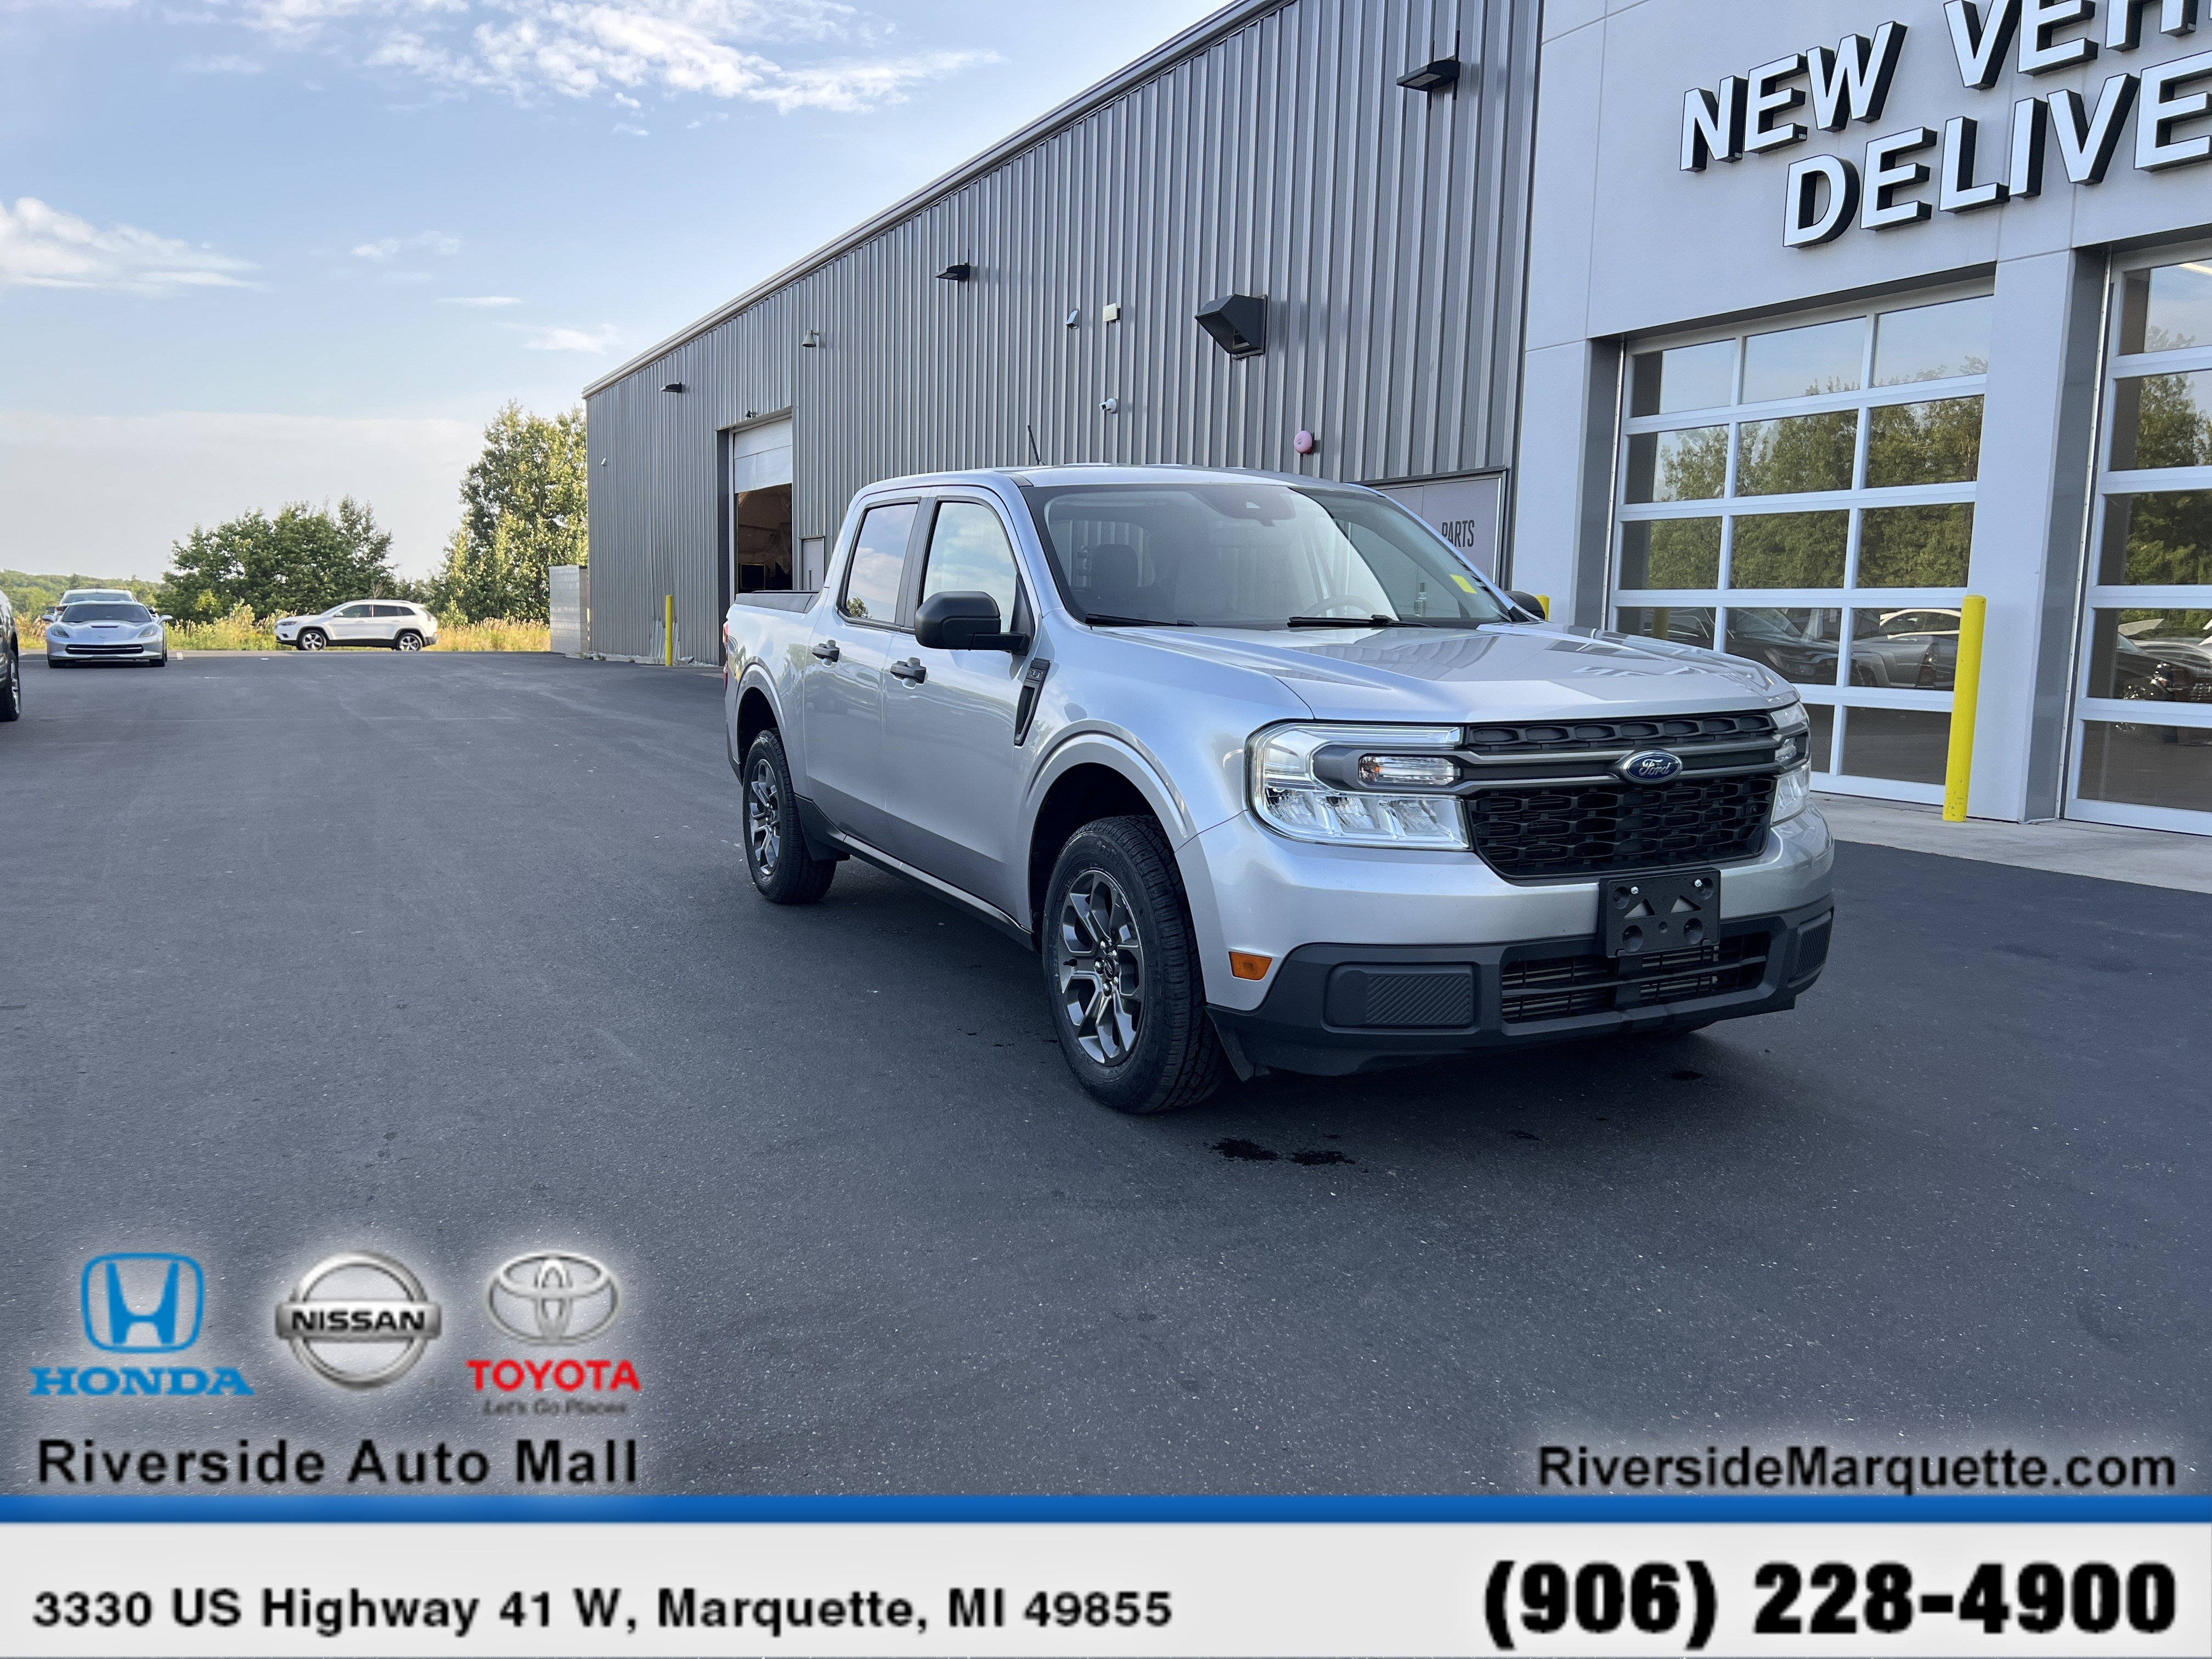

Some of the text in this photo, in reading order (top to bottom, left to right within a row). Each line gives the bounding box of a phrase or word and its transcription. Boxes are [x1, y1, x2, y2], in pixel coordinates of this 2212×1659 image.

[1680, 0, 2212, 172] NEW VE
[1783, 49, 2212, 249] DELIVE
[1441, 519, 1475, 548] PARTS
[1639, 758, 1671, 776] Ford
